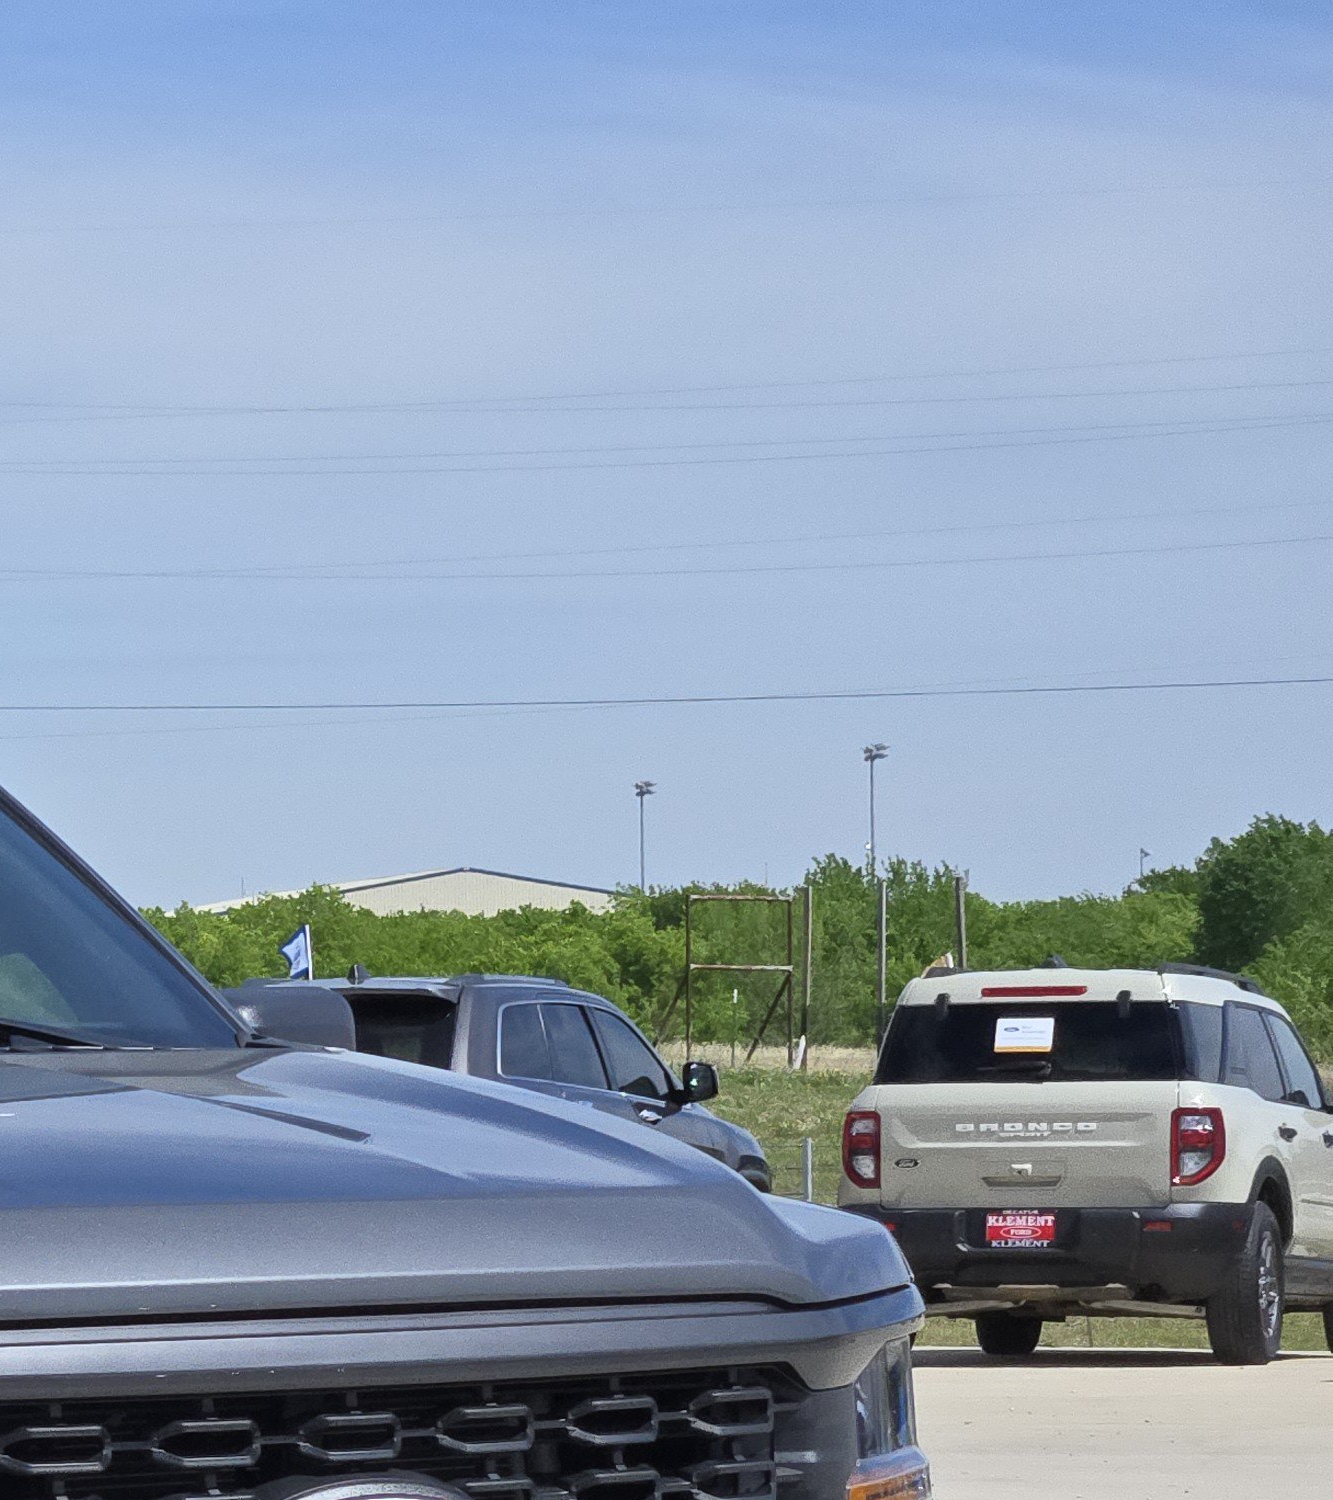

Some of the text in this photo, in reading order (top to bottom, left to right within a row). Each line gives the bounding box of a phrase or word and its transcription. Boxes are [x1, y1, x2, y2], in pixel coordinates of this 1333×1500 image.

[955, 1122, 1097, 1132] BRONCO
[987, 1215, 1055, 1227] KLEMENT
[991, 1239, 1050, 1248] KLEMENT
